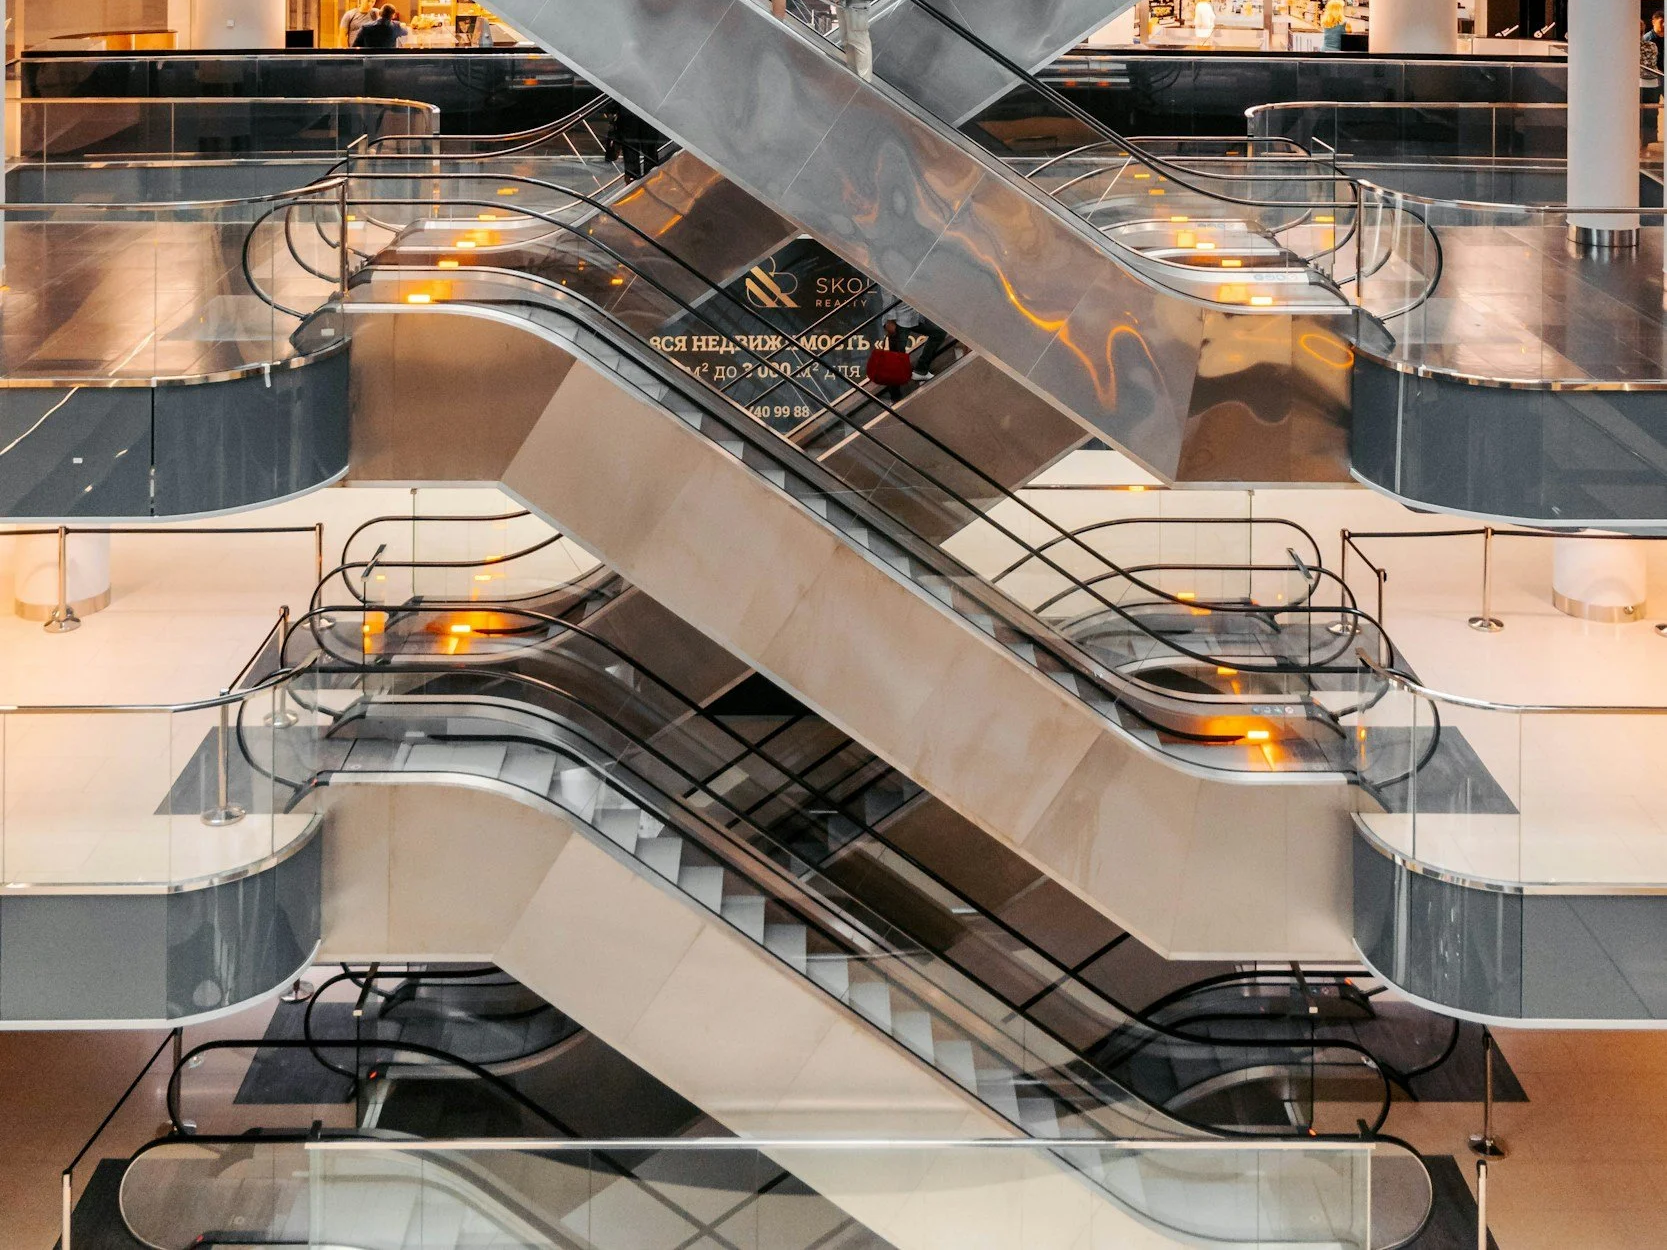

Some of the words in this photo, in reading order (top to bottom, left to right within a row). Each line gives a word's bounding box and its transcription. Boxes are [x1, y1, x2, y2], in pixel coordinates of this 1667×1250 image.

[815, 299, 868, 307] REATY
[773, 405, 790, 418] 99
[793, 405, 810, 418] 88
